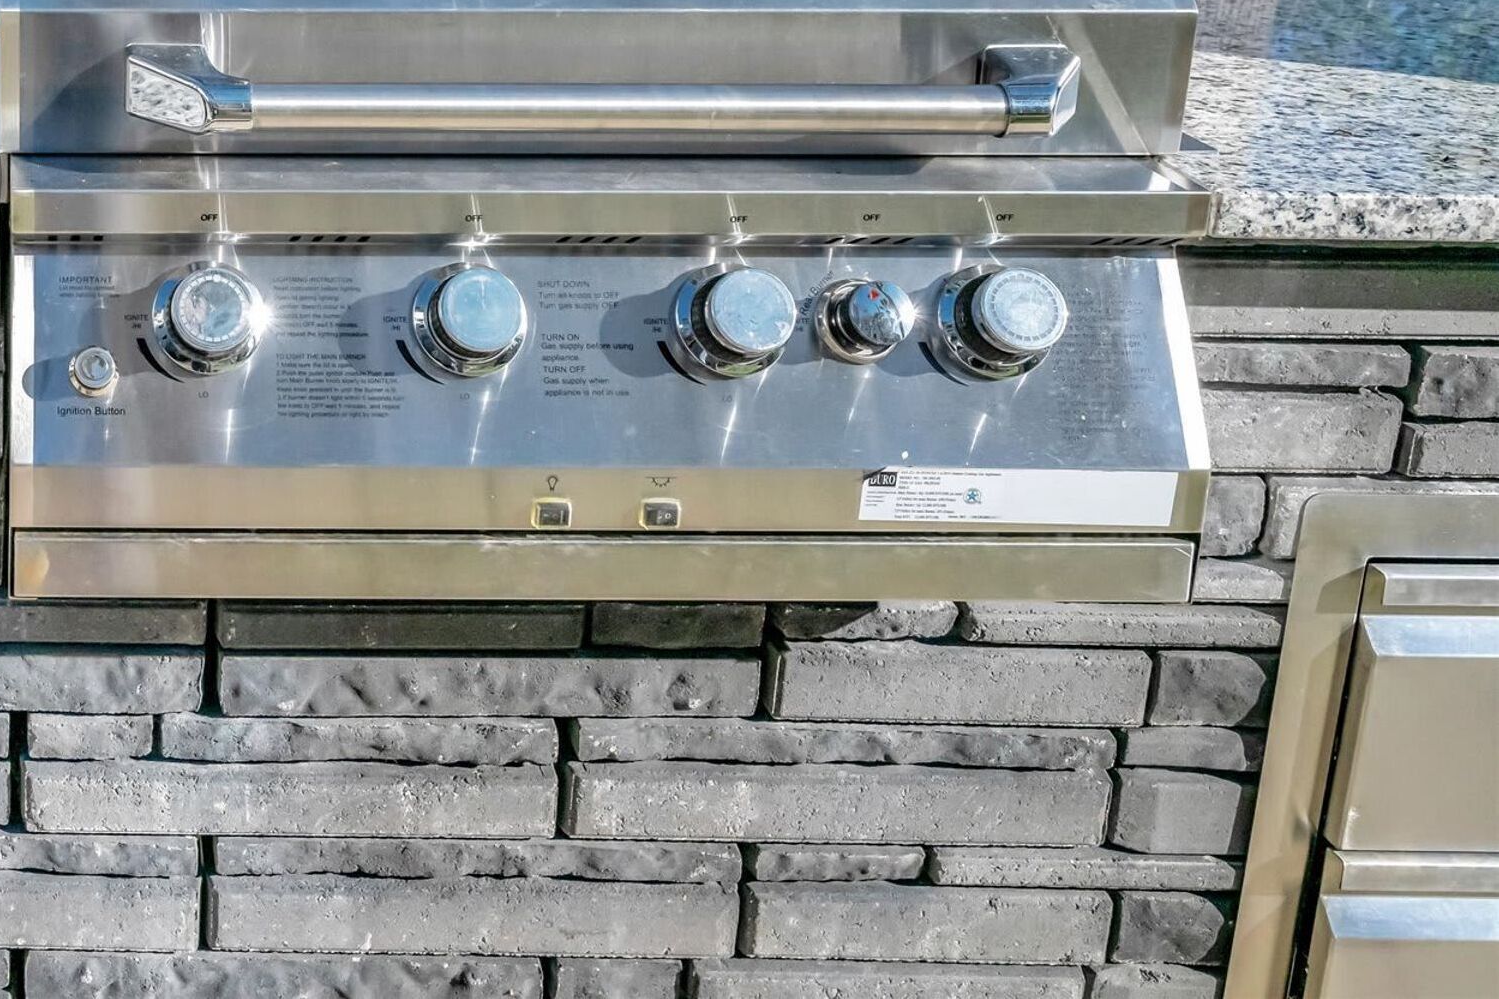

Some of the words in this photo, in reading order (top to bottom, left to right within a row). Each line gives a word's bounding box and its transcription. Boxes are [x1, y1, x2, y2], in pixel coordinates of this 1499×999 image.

[201, 214, 218, 222] OFF
[465, 214, 483, 222] OFF
[863, 214, 881, 222] OFF
[996, 214, 1014, 222] OFF
[59, 276, 112, 284] IMPORTANT
[538, 280, 559, 288] SHUT
[539, 291, 556, 299] Turn
[800, 295, 813, 316] Rear
[541, 342, 556, 350] Gas
[559, 343, 584, 351] supply
[586, 342, 611, 350] before
[612, 343, 634, 351] using
[562, 378, 587, 386] supply
[57, 406, 92, 415] Ignition
[94, 406, 125, 415] Button
[870, 474, 896, 486] DURO
